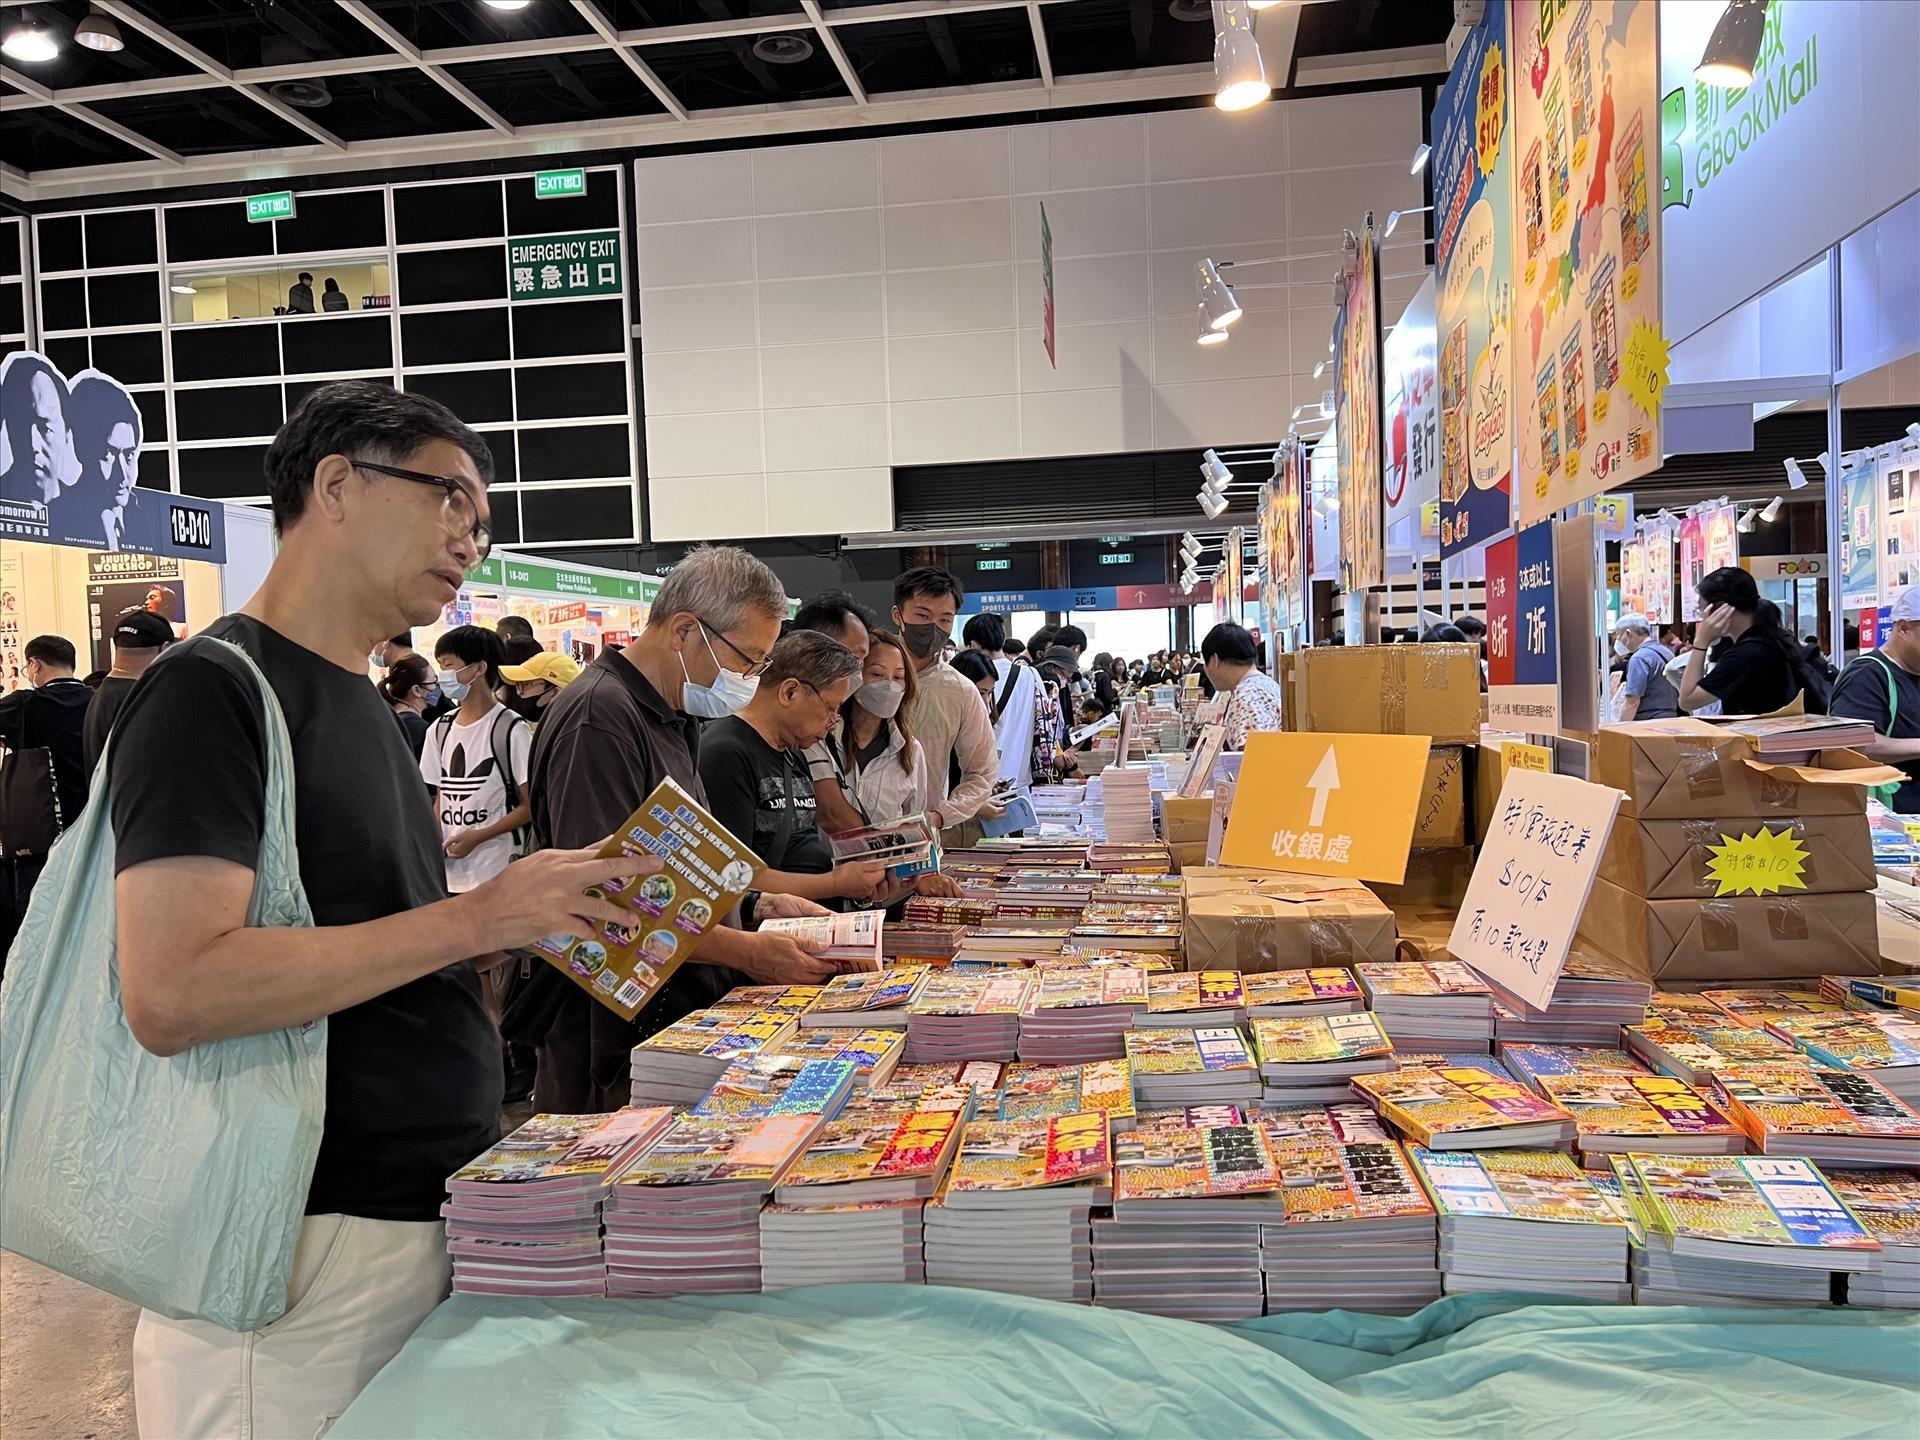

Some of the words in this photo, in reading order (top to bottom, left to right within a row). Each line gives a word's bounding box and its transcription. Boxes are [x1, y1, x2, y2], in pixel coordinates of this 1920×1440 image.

[1481, 64, 1499, 115] 特價
[1696, 32, 1819, 189] GBookMall
[1479, 110, 1499, 158] $10
[511, 242, 587, 264] EMERGENCY
[589, 239, 616, 258] EXIT
[513, 263, 617, 293] 緊急出口
[1412, 408, 1435, 481] 發行
[171, 507, 210, 546] 1B-D10
[94, 561, 153, 573] WORKSHOP
[482, 565, 492, 577] HK
[509, 569, 529, 582] 1B-D02
[1519, 560, 1552, 592] 3本或以上
[1491, 575, 1507, 600] 1-2本
[549, 606, 569, 624] 7折
[981, 604, 1005, 612] SPORTS
[1491, 614, 1508, 658] 8折
[1525, 605, 1547, 655] 7折
[1271, 829, 1353, 863] 收銀處
